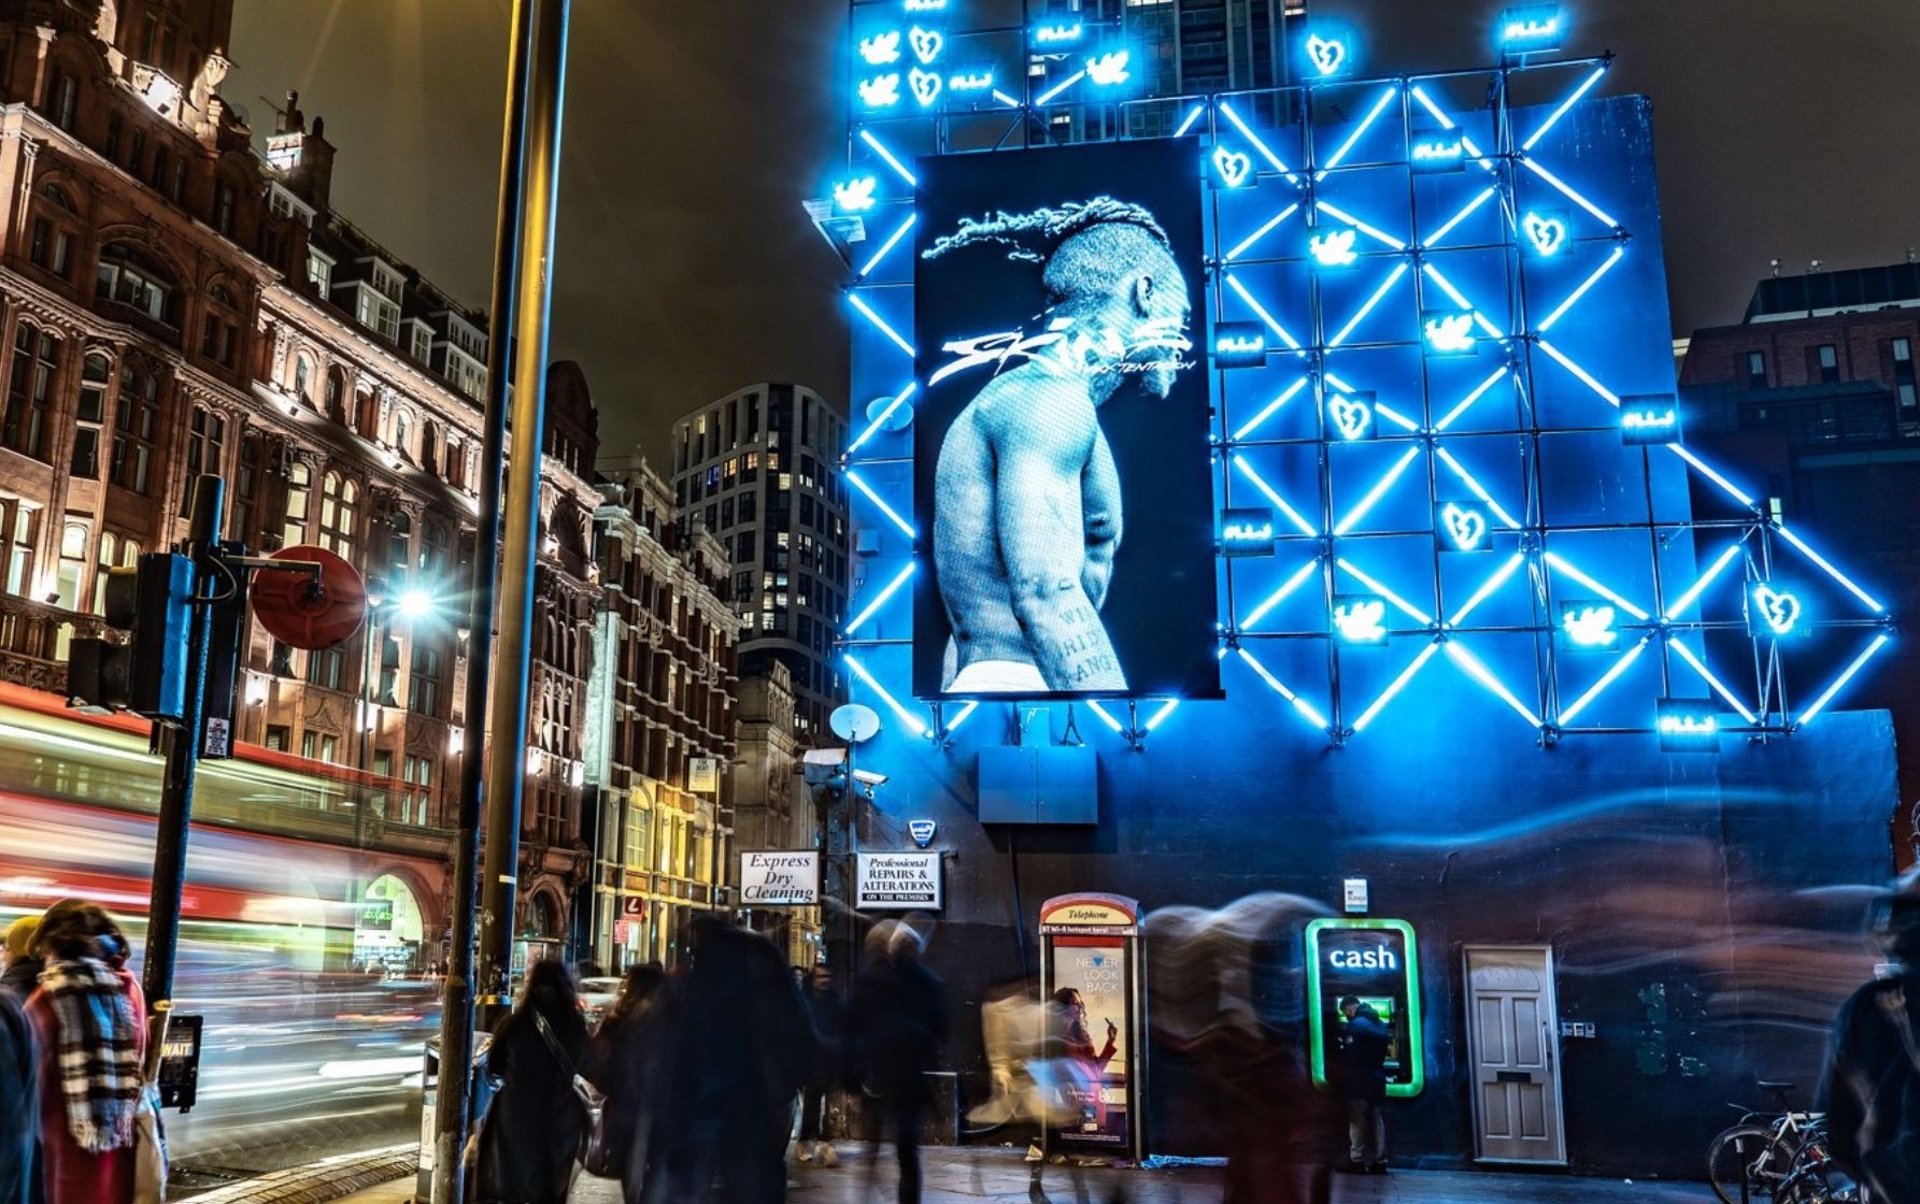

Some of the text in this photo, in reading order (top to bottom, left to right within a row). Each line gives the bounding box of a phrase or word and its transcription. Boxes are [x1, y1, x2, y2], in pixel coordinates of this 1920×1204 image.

[750, 854, 811, 871] Express
[870, 858, 928, 868] Professional
[869, 869, 927, 879] REPAIRS &
[764, 871, 793, 888] Dry
[862, 881, 935, 891] ALTERATIONS
[744, 885, 813, 903] Cleaning
[1068, 910, 1109, 920] Telephone
[1330, 945, 1396, 969] cash
[1084, 970, 1118, 980] LOOK
[1087, 982, 1118, 992] BACK
[161, 1043, 191, 1057] WAIT
